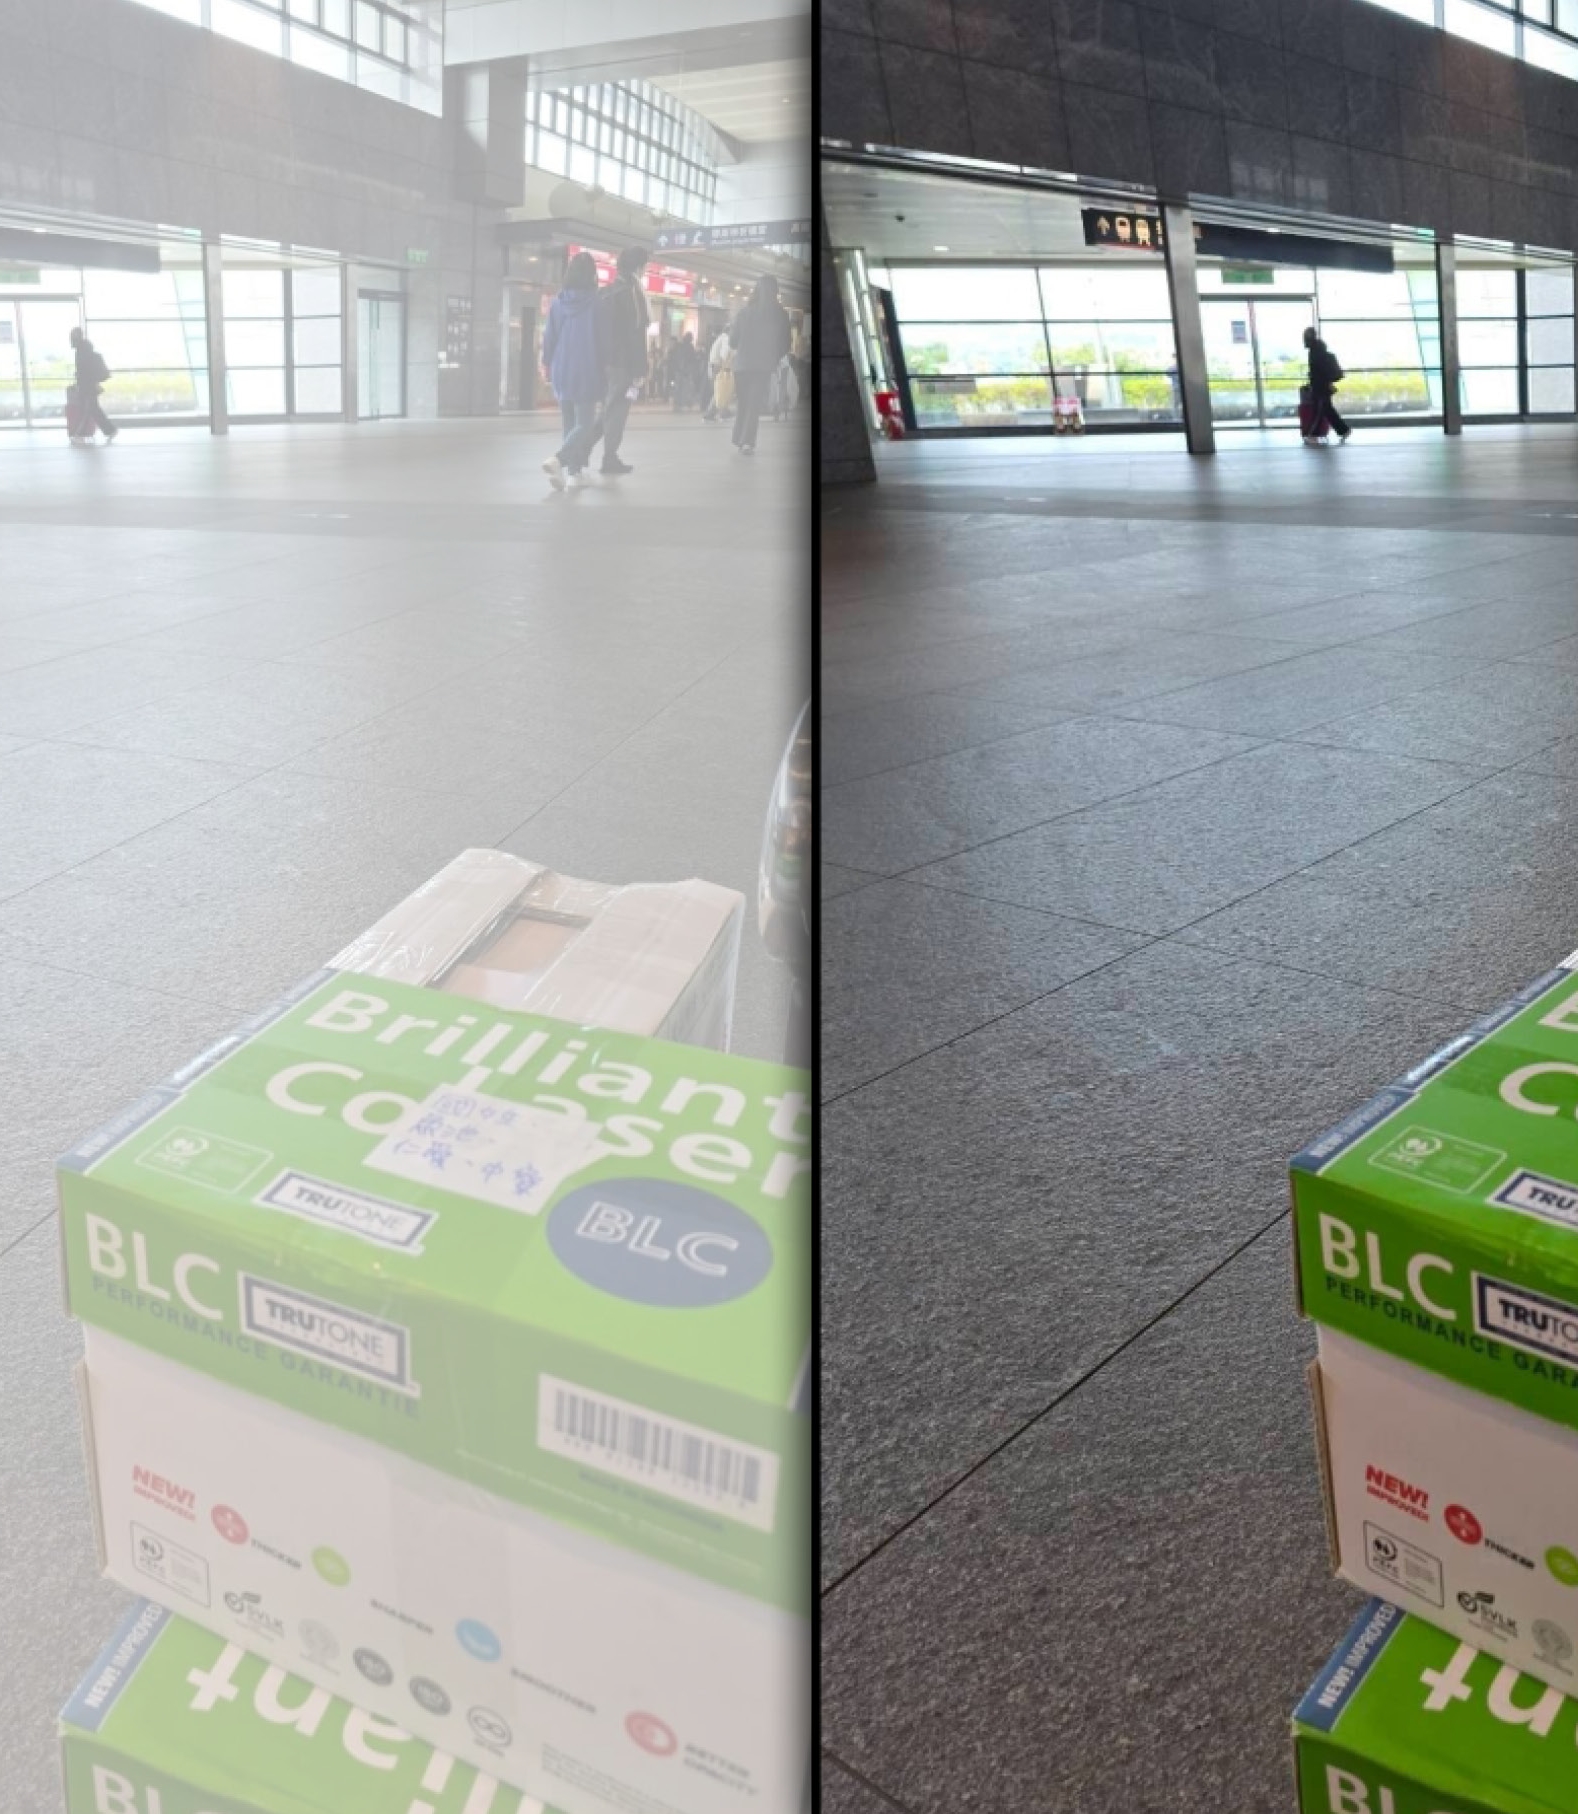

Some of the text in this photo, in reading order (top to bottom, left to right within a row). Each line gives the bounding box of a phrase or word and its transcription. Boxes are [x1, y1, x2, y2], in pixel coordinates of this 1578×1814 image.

[86, 1211, 224, 1322] BLC
[1319, 1211, 1457, 1322] BLC
[1325, 1275, 1501, 1361] PERFORMANCE
[1365, 1464, 1429, 1509] NEW!
